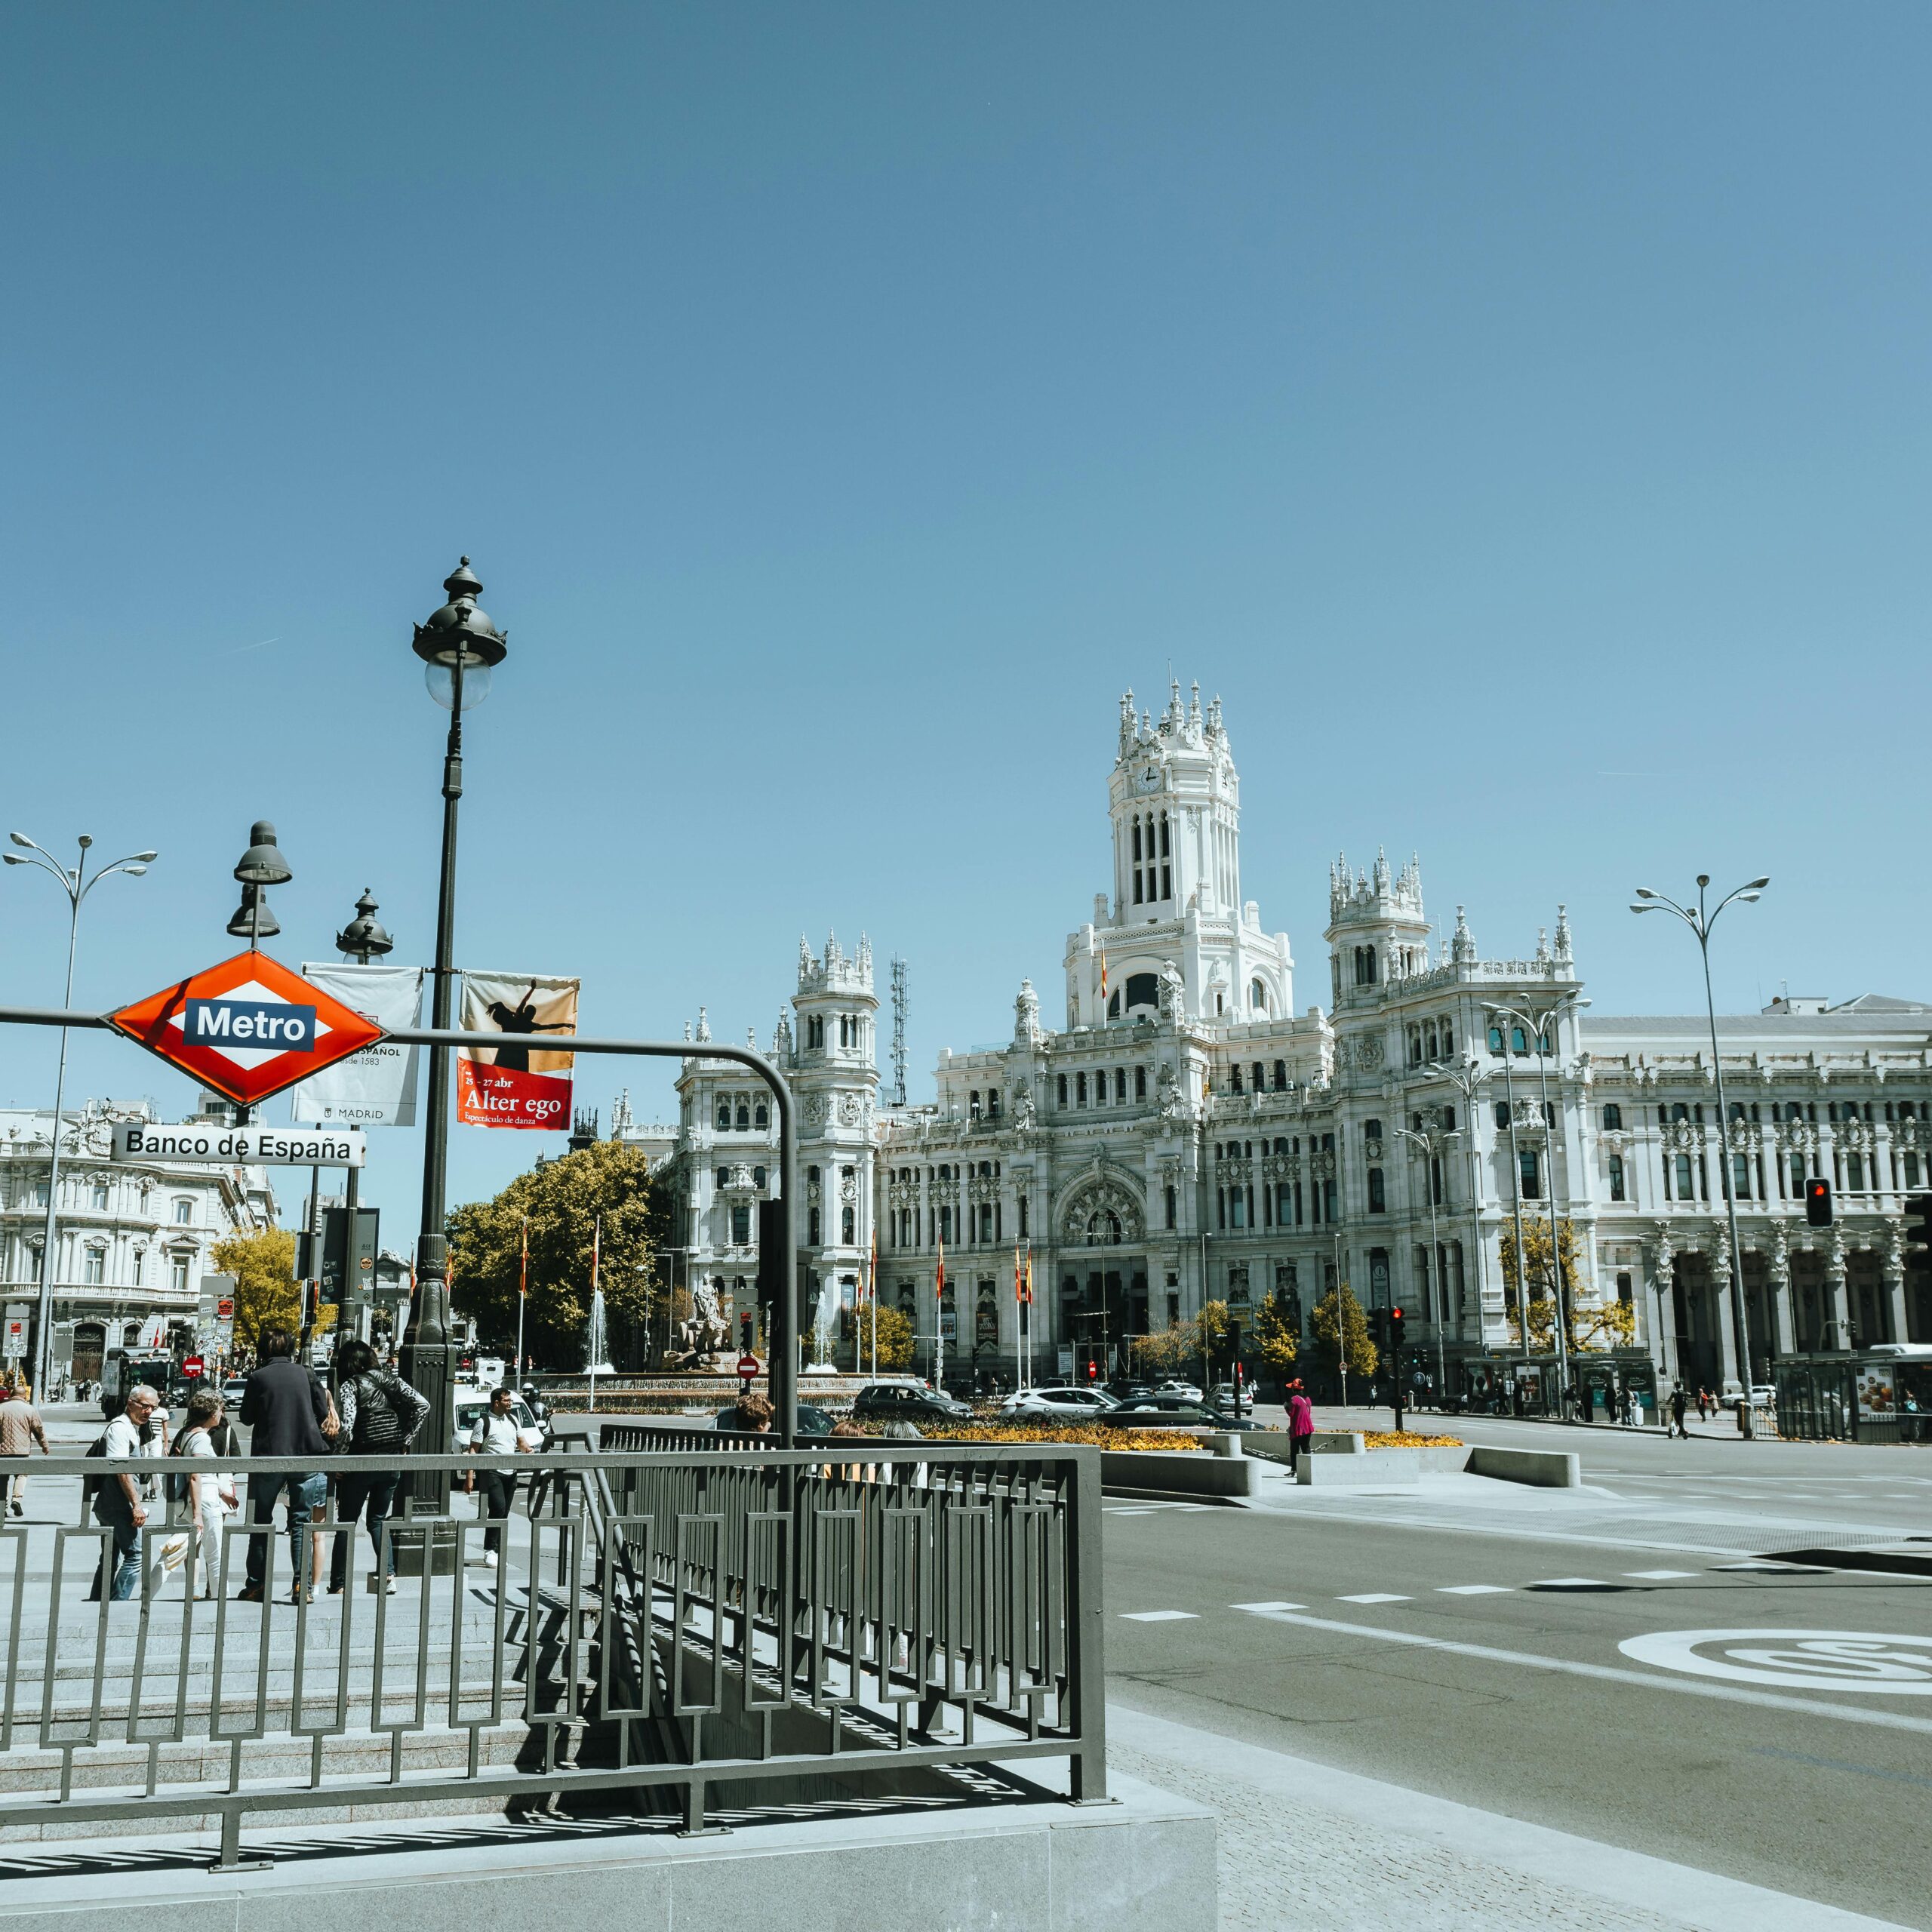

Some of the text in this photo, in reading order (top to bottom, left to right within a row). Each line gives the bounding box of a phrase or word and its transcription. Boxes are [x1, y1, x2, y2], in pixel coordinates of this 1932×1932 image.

[197, 1006, 306, 1041] Metro
[355, 1047, 401, 1057] SPAÑOL
[340, 1057, 358, 1065] esde
[465, 1077, 473, 1085] 25
[494, 1077, 513, 1088] abr
[465, 1090, 561, 1119] Alter ego
[339, 1109, 383, 1119] MADRID
[465, 1112, 503, 1123] Espectáculo
[126, 1131, 351, 1162] Banco de España
